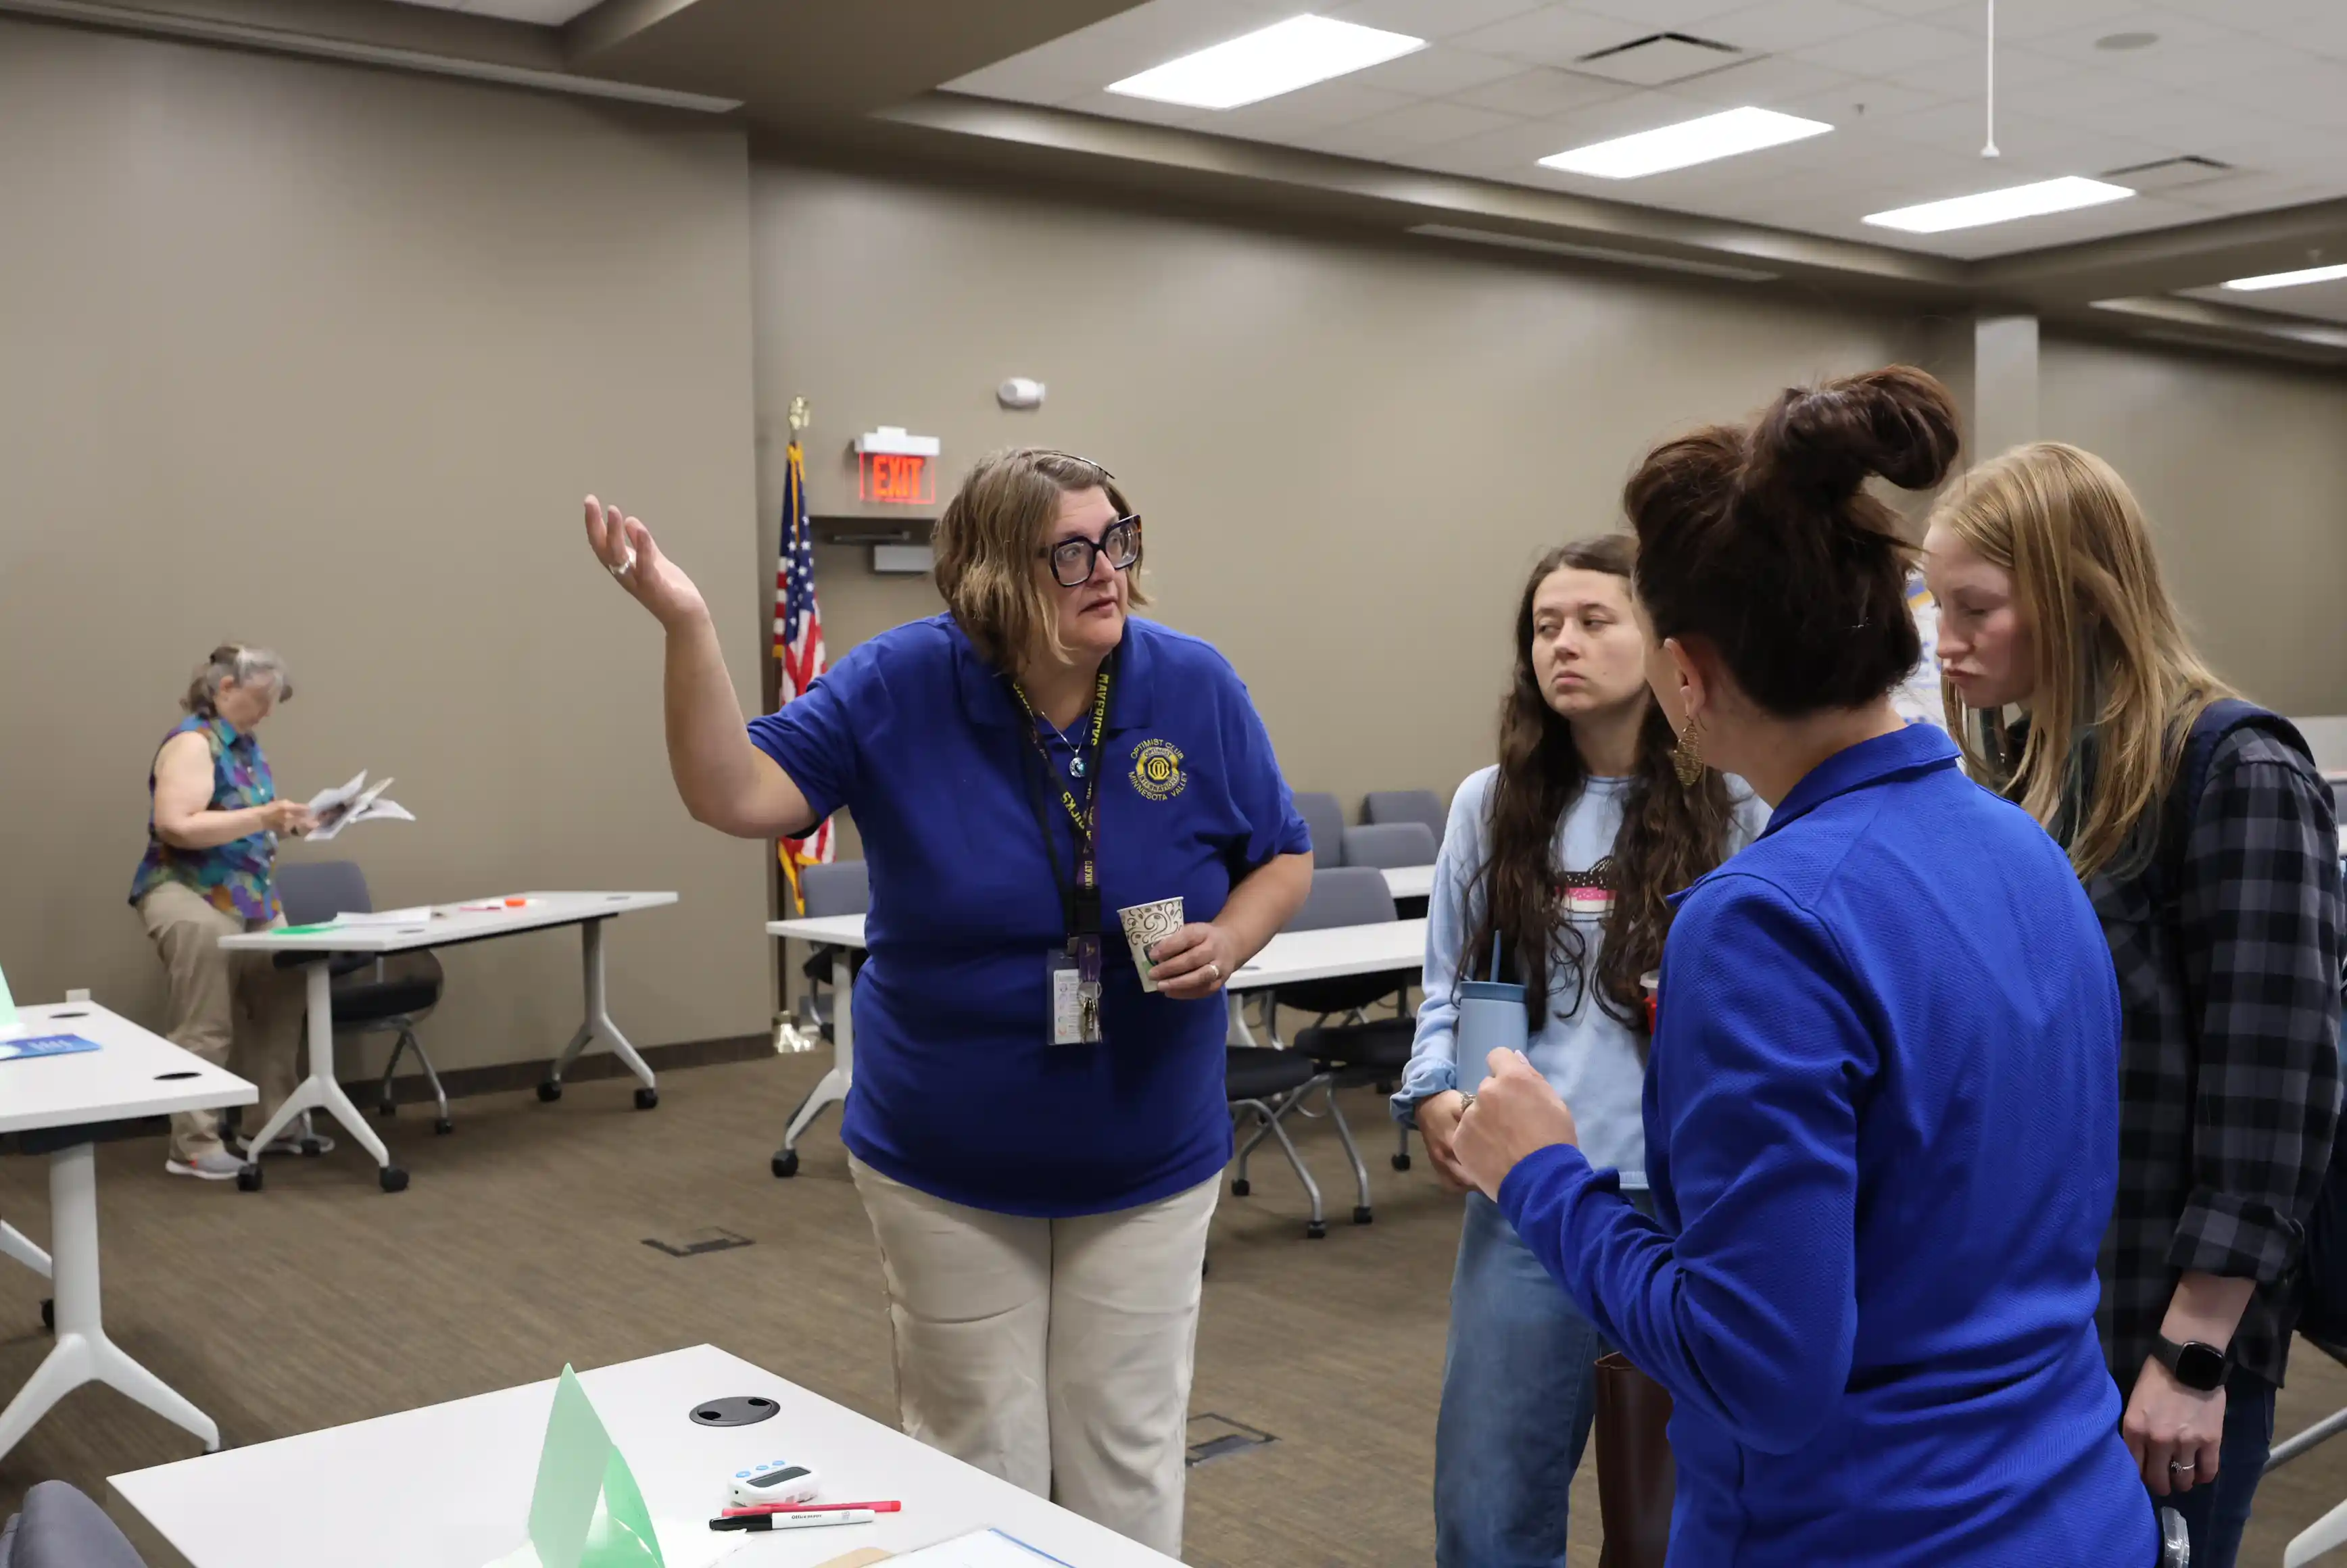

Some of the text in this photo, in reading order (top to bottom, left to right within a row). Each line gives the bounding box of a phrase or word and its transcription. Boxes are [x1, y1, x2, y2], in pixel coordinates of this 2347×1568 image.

[873, 456, 924, 498] EXIT
[1130, 738, 1184, 760] OPTIMIST CLUB
[1128, 770, 1187, 801] MINNESOTA VALLEY
[1084, 860, 1093, 889] ANKATO
